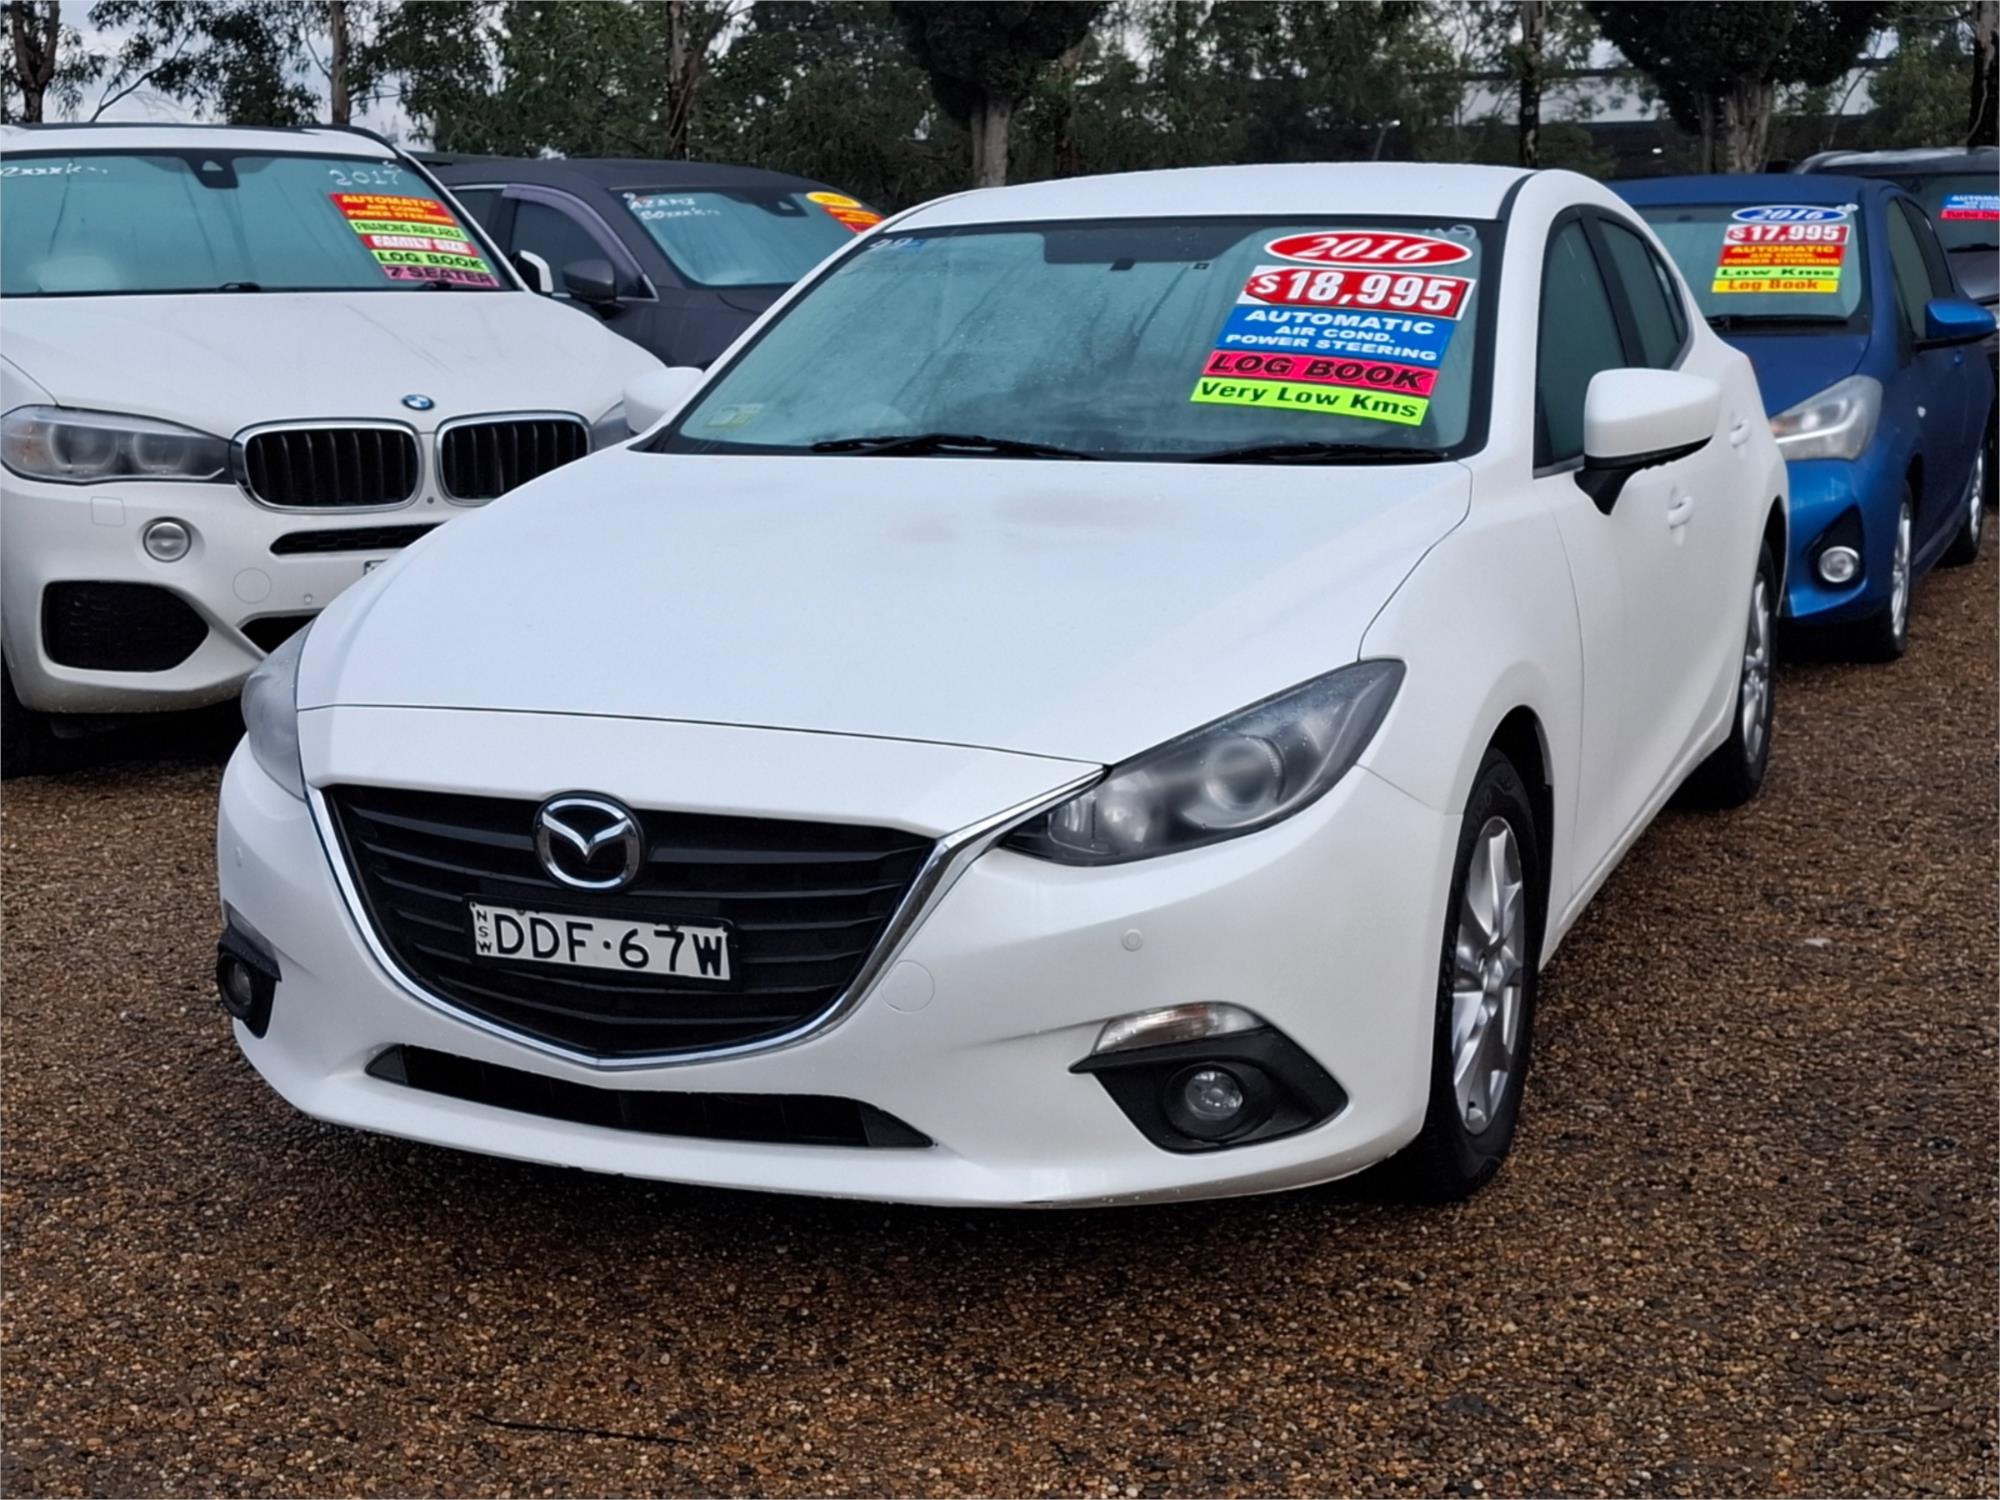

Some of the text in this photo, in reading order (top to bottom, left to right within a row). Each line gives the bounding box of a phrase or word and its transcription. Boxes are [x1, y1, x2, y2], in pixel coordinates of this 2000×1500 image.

[342, 194, 438, 209] AUTOMATIC
[1751, 208, 1825, 221] 2016
[1731, 225, 1840, 242] $17,995
[1292, 234, 1438, 261] 2016
[1731, 245, 1836, 254] AUTOMATIC
[377, 251, 484, 270] LOG BOOK
[384, 266, 495, 286] 7 SEATER
[1721, 268, 1835, 276] Low Kms
[1253, 269, 1458, 312] $18,995
[1727, 279, 1819, 291] Log Book
[1245, 309, 1436, 335] AUTOMATIC
[1275, 325, 1396, 344] AIR COND.
[1225, 334, 1438, 361] POWER STEERING
[1208, 353, 1432, 389] LOG BOOK
[1202, 382, 1418, 418] Very Low Kms
[475, 910, 492, 954] NSW
